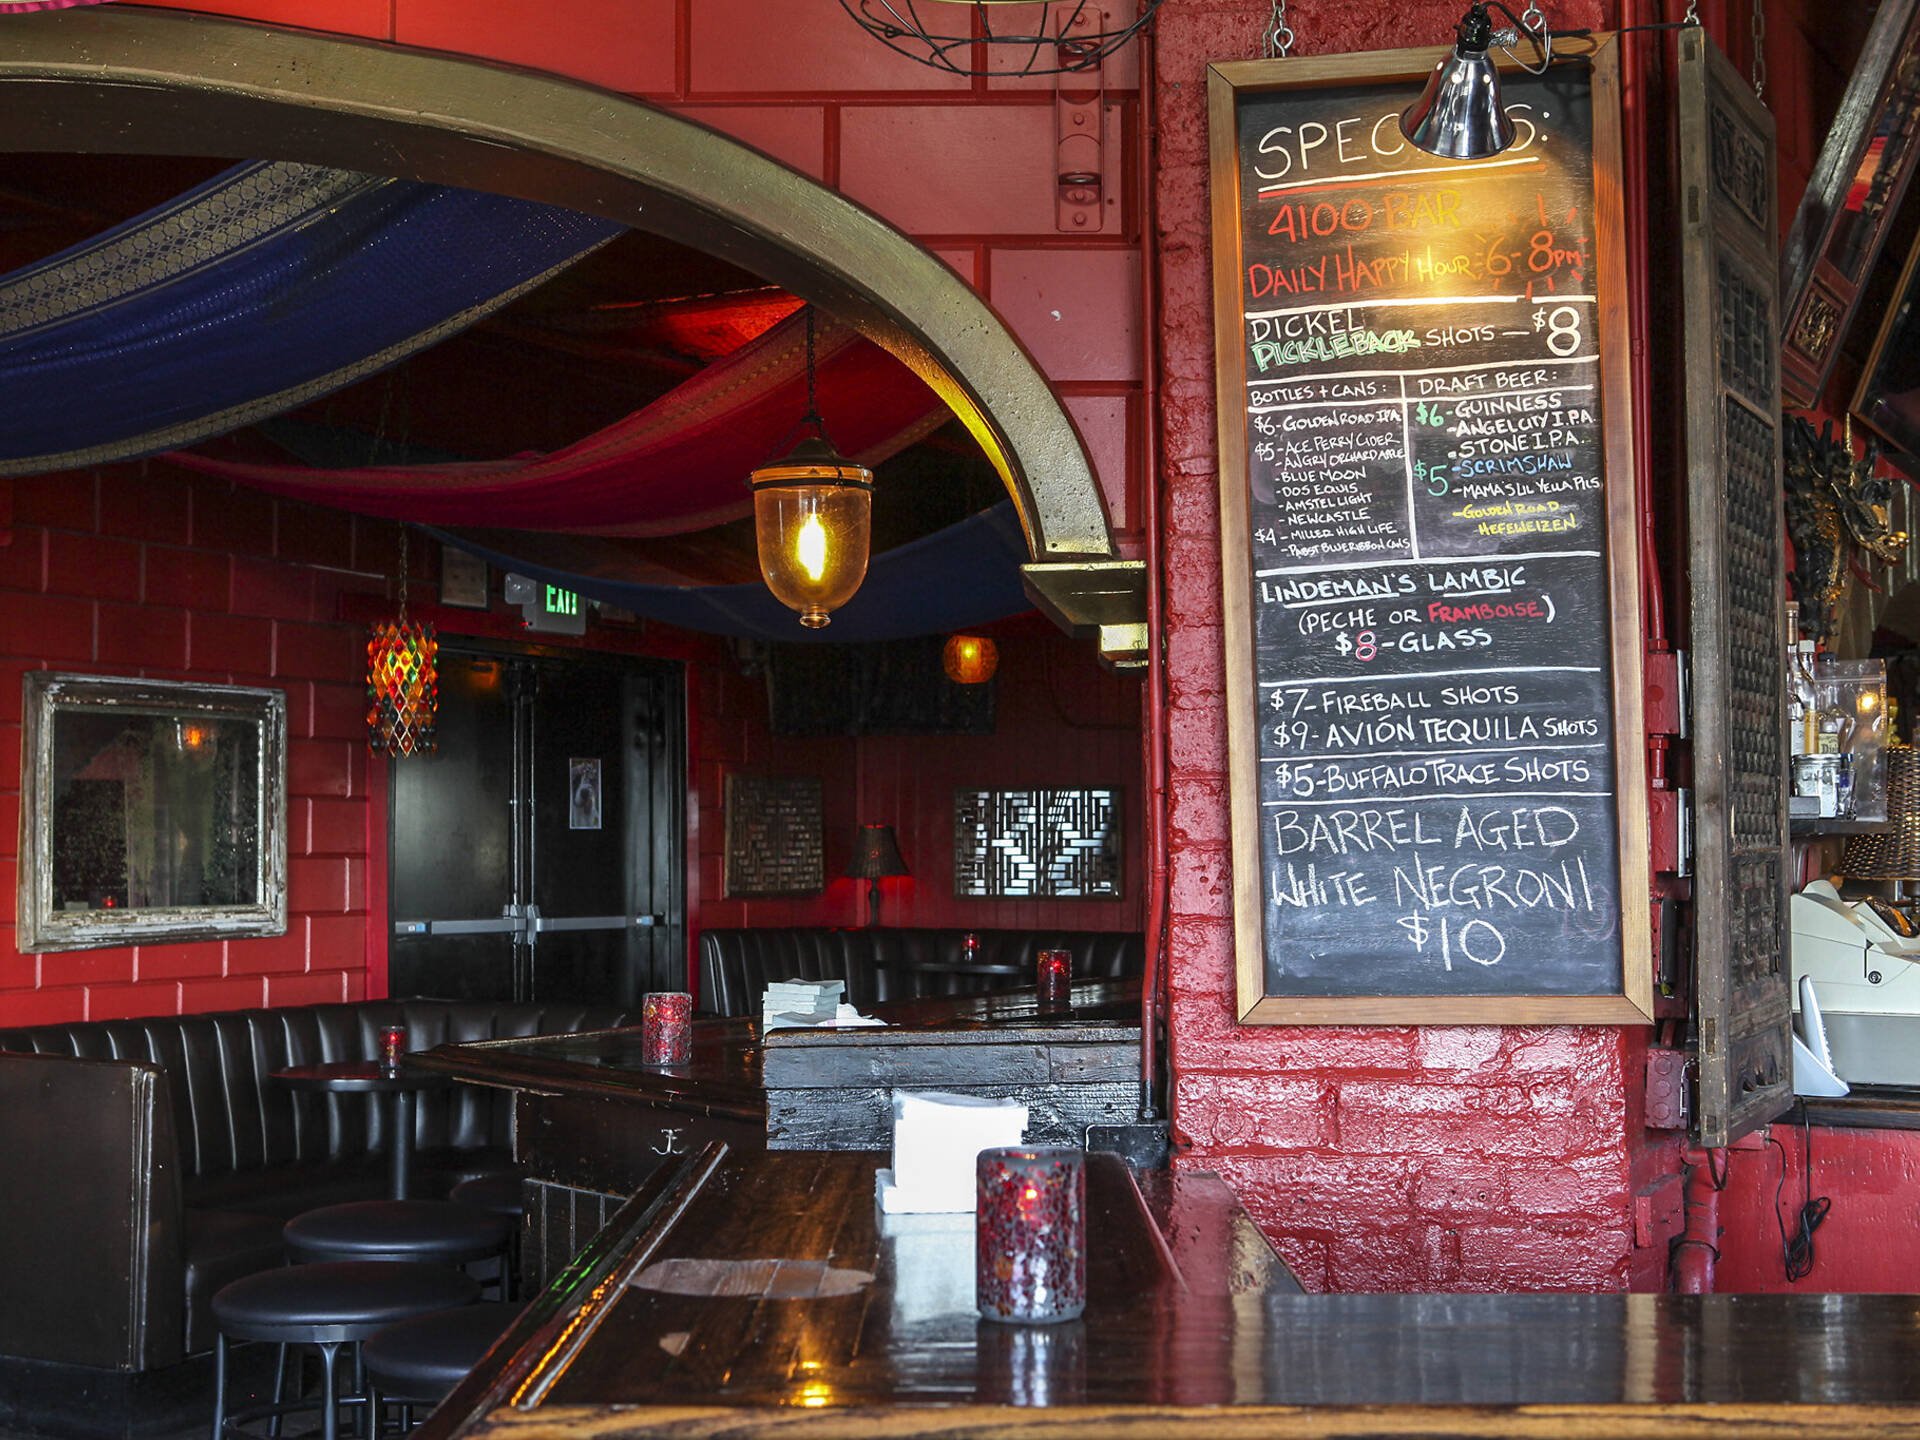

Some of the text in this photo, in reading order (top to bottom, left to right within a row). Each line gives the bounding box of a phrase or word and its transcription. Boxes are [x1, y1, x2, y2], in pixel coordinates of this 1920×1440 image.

[1268, 189, 1461, 243] 4100 BAR
[1250, 256, 1326, 298] DAILY
[1336, 245, 1409, 292] HAPPY
[1252, 308, 1364, 342] DICKEL
[1250, 306, 1581, 371] PICKLEBACK SHOTS $8
[1250, 385, 1314, 406] BOTTLES
[1332, 381, 1386, 398] CANS:
[1417, 369, 1557, 395] DRAFT BEER:
[1376, 409, 1401, 423] IPA
[1415, 401, 1444, 427] $6
[1517, 411, 1549, 428] CITY
[1314, 432, 1354, 451] PERRY
[1356, 432, 1400, 446] CIDER
[1329, 449, 1376, 466] ORCHARD
[1377, 448, 1406, 461] APPLE
[1320, 466, 1367, 482] MOON
[1413, 459, 1448, 496] $5
[1536, 478, 1573, 493] YELLA
[1313, 482, 1358, 495] EQUIS
[1339, 493, 1373, 506] LIGHT
[1514, 501, 1560, 514] ROAD
[1254, 528, 1277, 546] $4
[1336, 526, 1365, 537] HIGH
[1368, 522, 1398, 534] LIFE
[1478, 512, 1577, 536] HEFEWEIZEN
[1386, 538, 1410, 550] CANS
[1261, 567, 1526, 602] LINDEMAN'S LAMBIC
[1389, 608, 1422, 624] OR
[1322, 691, 1432, 715] FIREBALL
[1441, 685, 1519, 706] SHOTS
[1419, 715, 1539, 745] TEQUILA
[1542, 717, 1598, 738] SHOTS
[1425, 758, 1501, 786] TRACE
[1503, 757, 1590, 784] SHOTS
[1273, 805, 1579, 855] BARREL AGED
[1393, 851, 1593, 911] NEGRONI
[1397, 909, 1506, 971] $10
